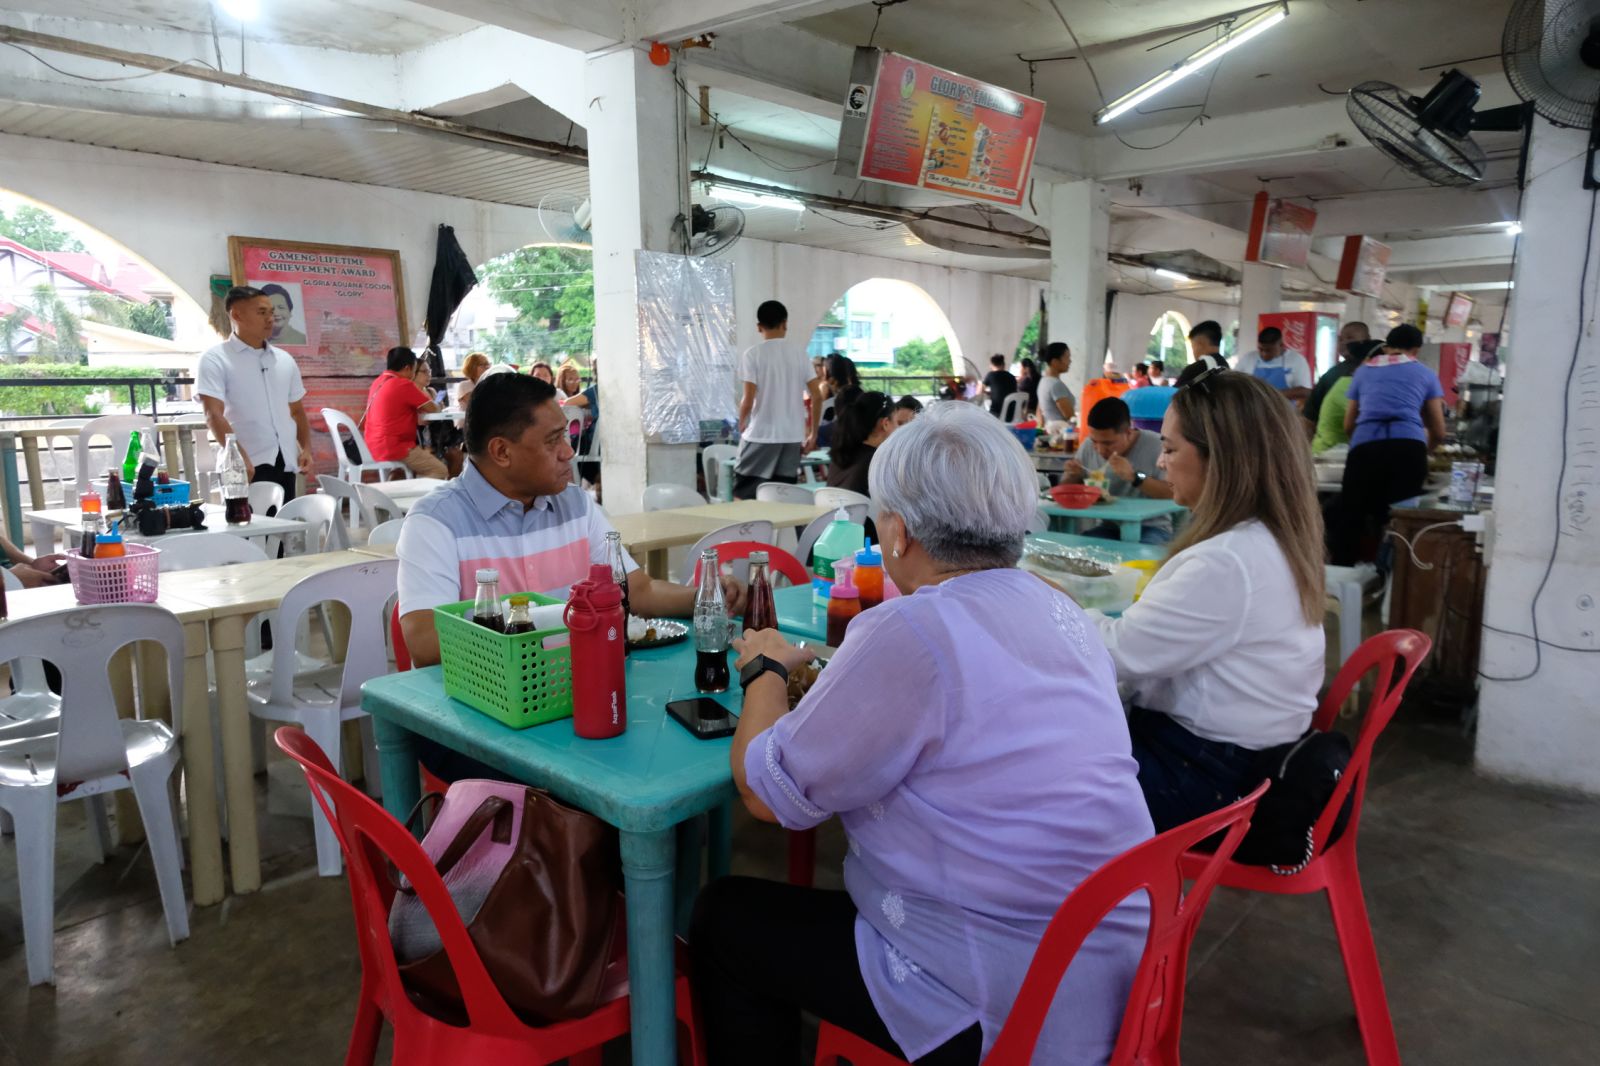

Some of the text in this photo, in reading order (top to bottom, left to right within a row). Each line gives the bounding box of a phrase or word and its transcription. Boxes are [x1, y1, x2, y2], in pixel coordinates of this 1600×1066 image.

[930, 75, 973, 102] GLORY'S
[270, 251, 366, 266] GAMENG LIFETIME
[261, 262, 376, 278] ACHIEVEMENT AWARD
[304, 279, 331, 287] GLORIA
